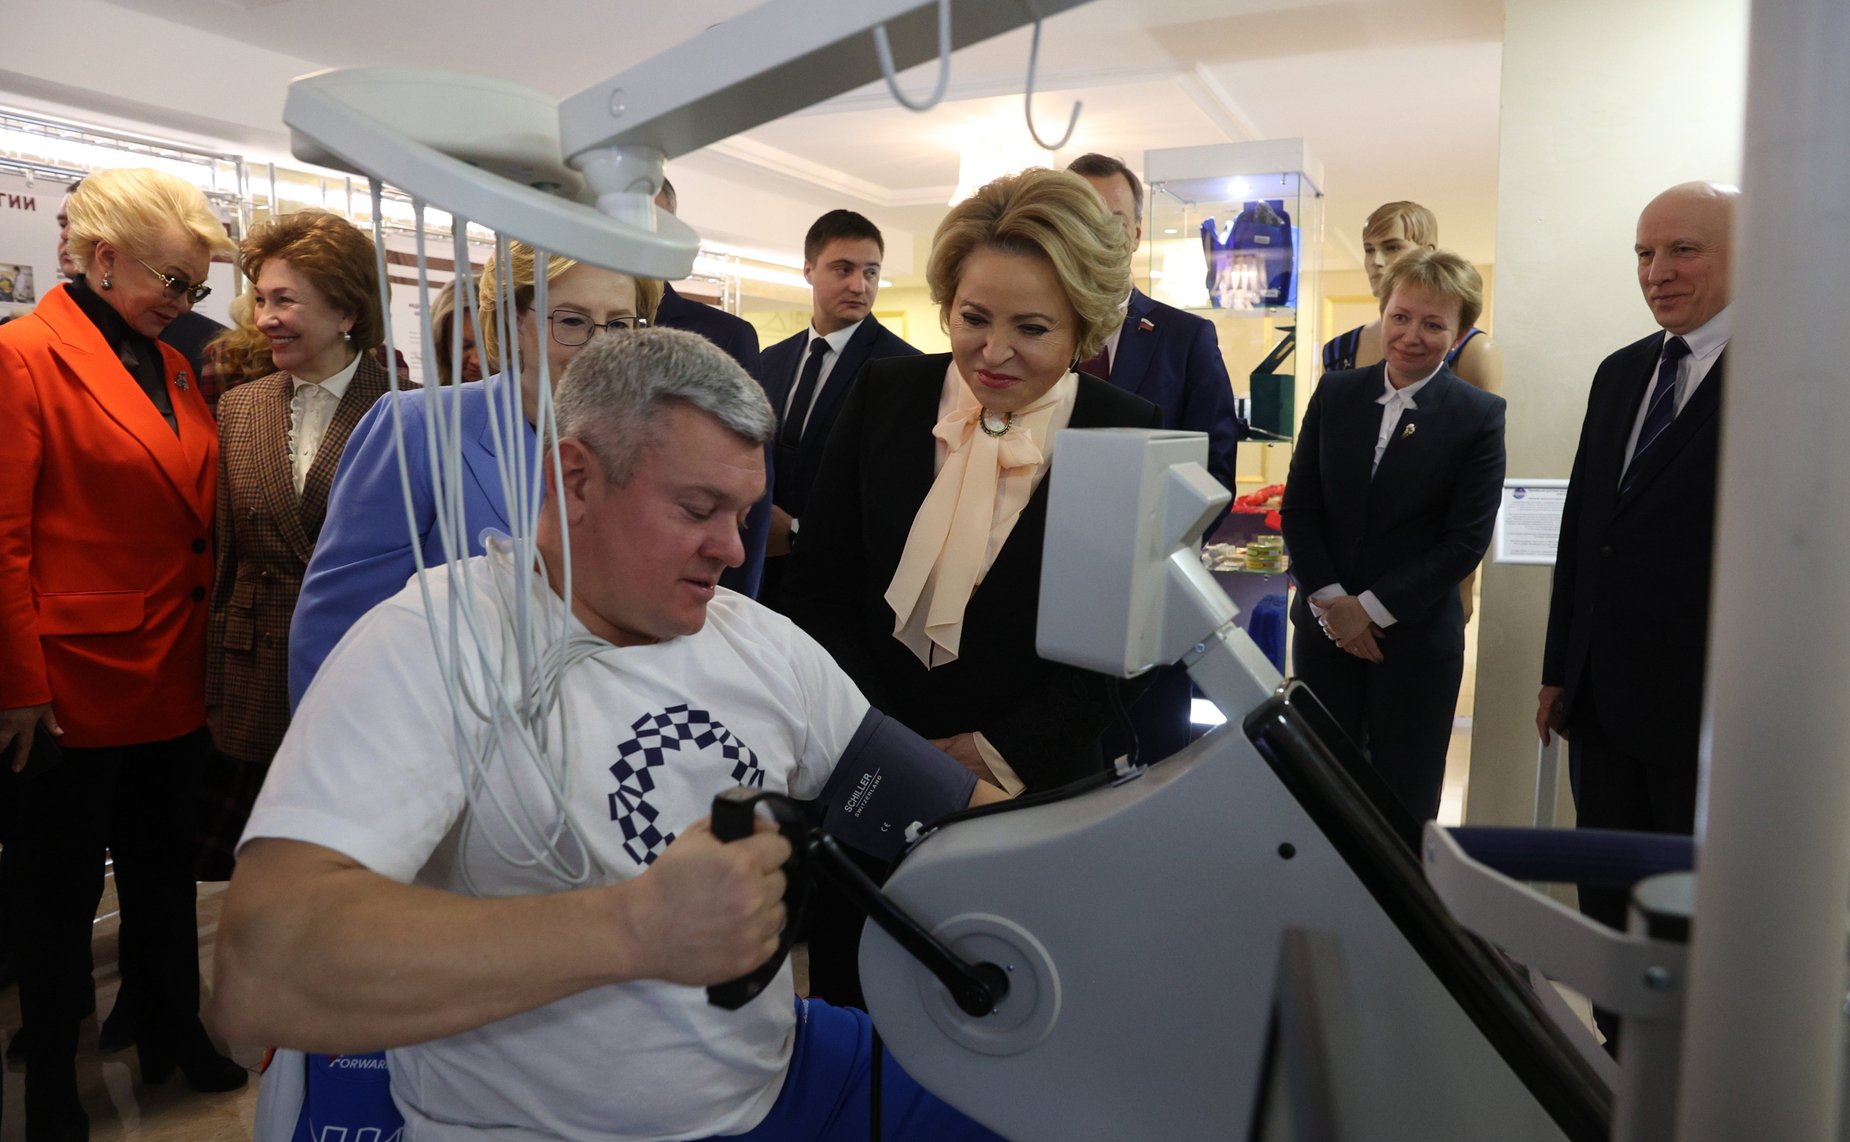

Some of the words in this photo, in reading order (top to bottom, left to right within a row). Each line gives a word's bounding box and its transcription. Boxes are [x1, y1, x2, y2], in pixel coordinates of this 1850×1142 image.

[844, 772, 873, 813] SCHILLER
[854, 775, 882, 818] SWITZERLAND
[329, 1055, 388, 1069] FORWAR
